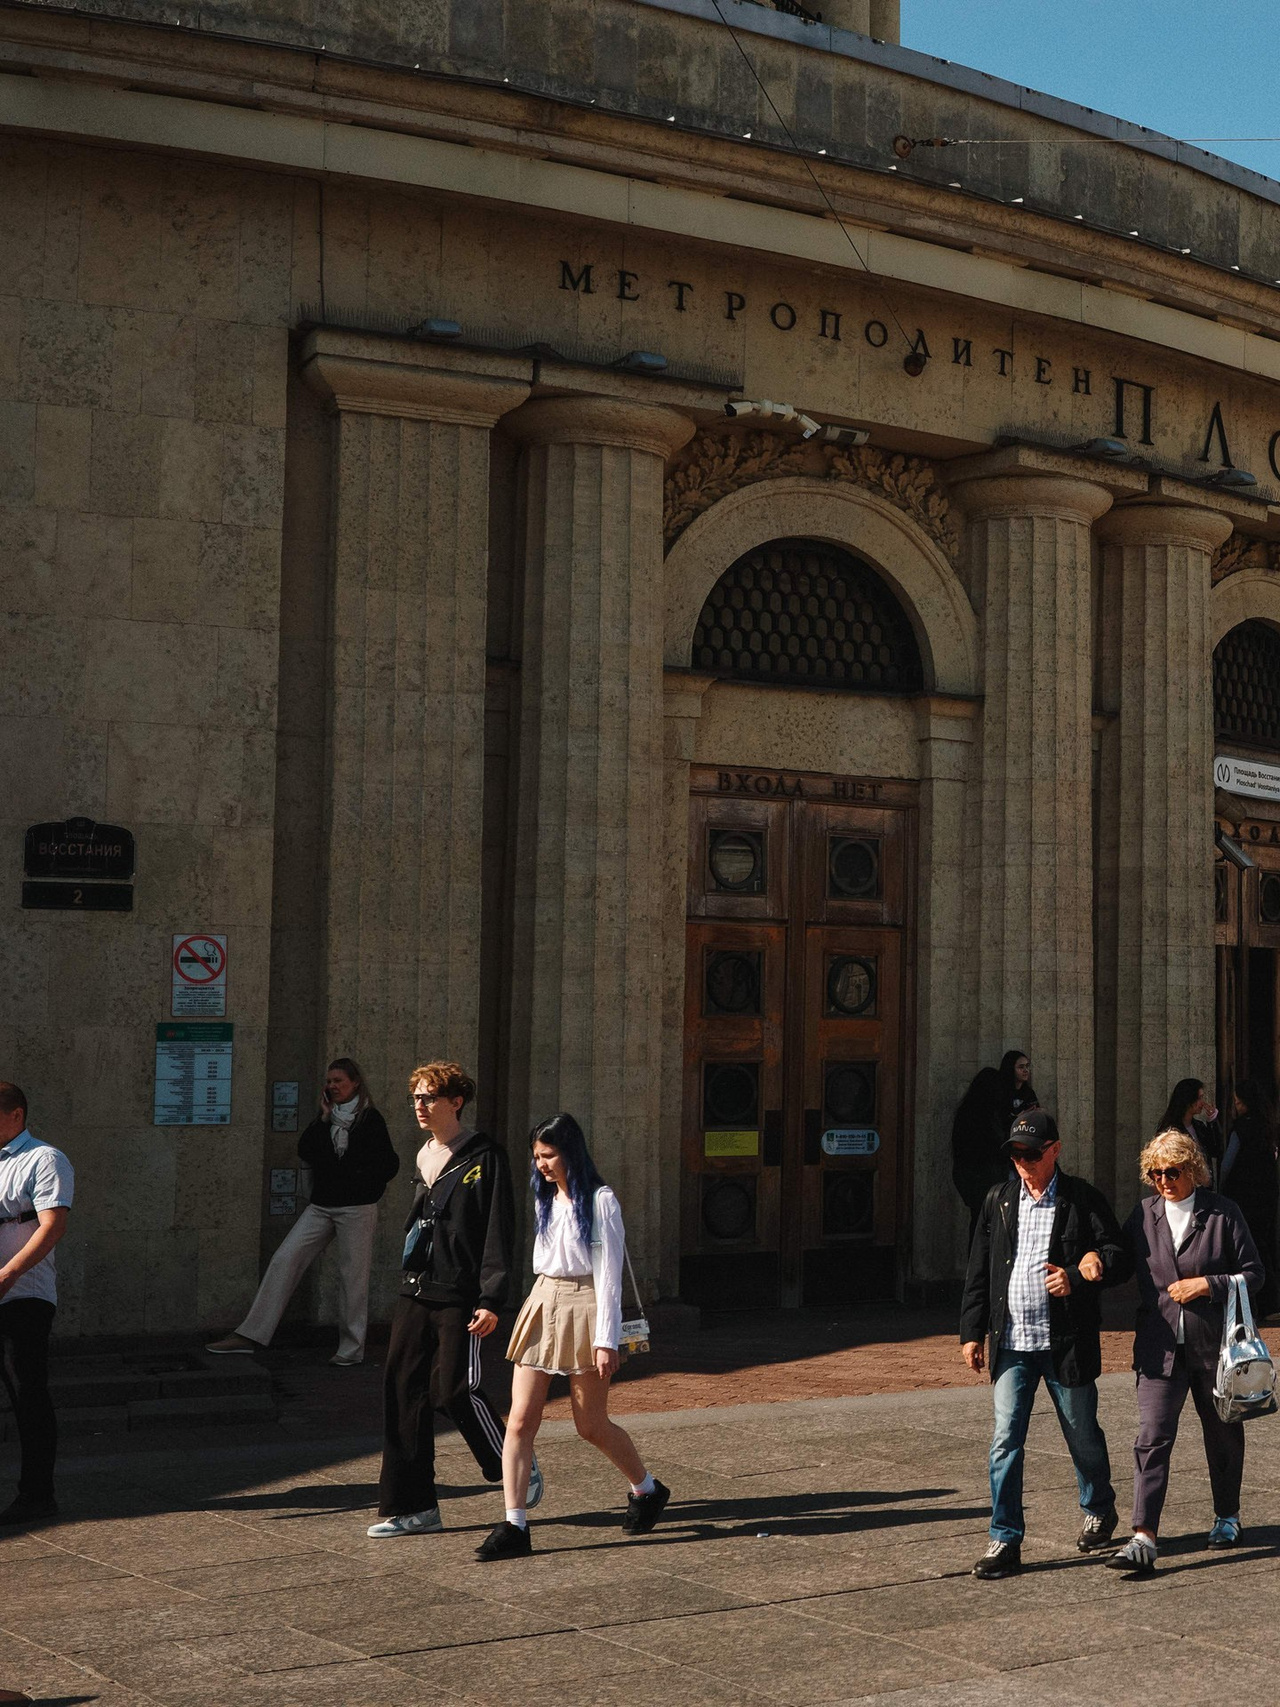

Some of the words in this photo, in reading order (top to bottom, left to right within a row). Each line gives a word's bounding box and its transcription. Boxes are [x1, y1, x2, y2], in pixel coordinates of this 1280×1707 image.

[557, 259, 1093, 396] МЕТРОПОЛИТЕН
[1233, 766, 1257, 779] Площадь
[831, 780, 883, 801] НЕТ
[38, 841, 122, 858] ВОССТАНИЯ
[73, 888, 83, 904] 2
